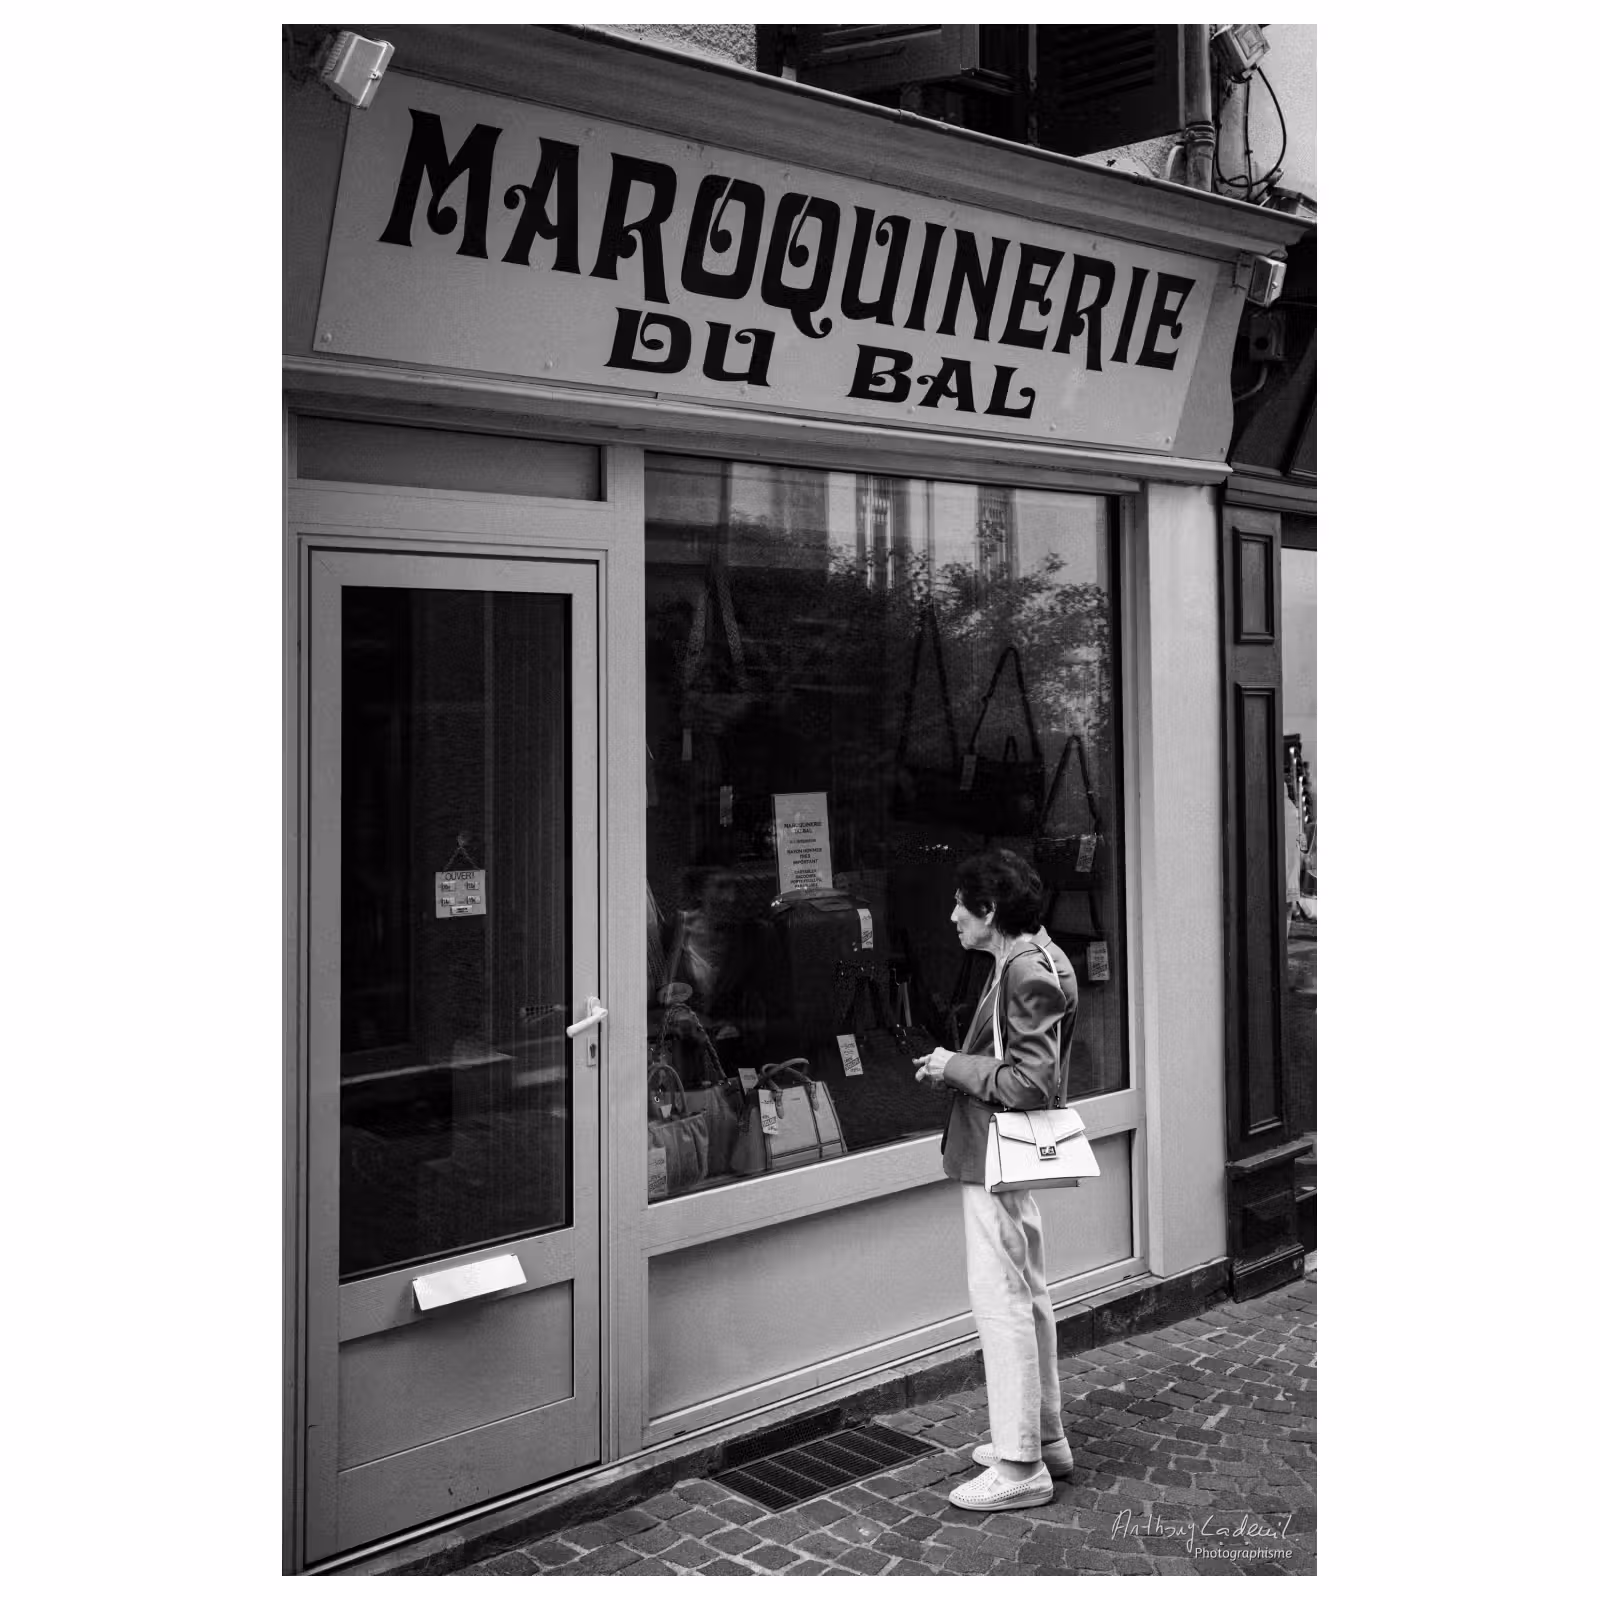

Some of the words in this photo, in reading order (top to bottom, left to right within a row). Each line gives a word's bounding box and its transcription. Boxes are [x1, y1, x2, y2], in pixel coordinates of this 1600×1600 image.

[379, 107, 1197, 372] MAROQUINERIE
[604, 307, 776, 387] DU
[847, 344, 1037, 419] BAL
